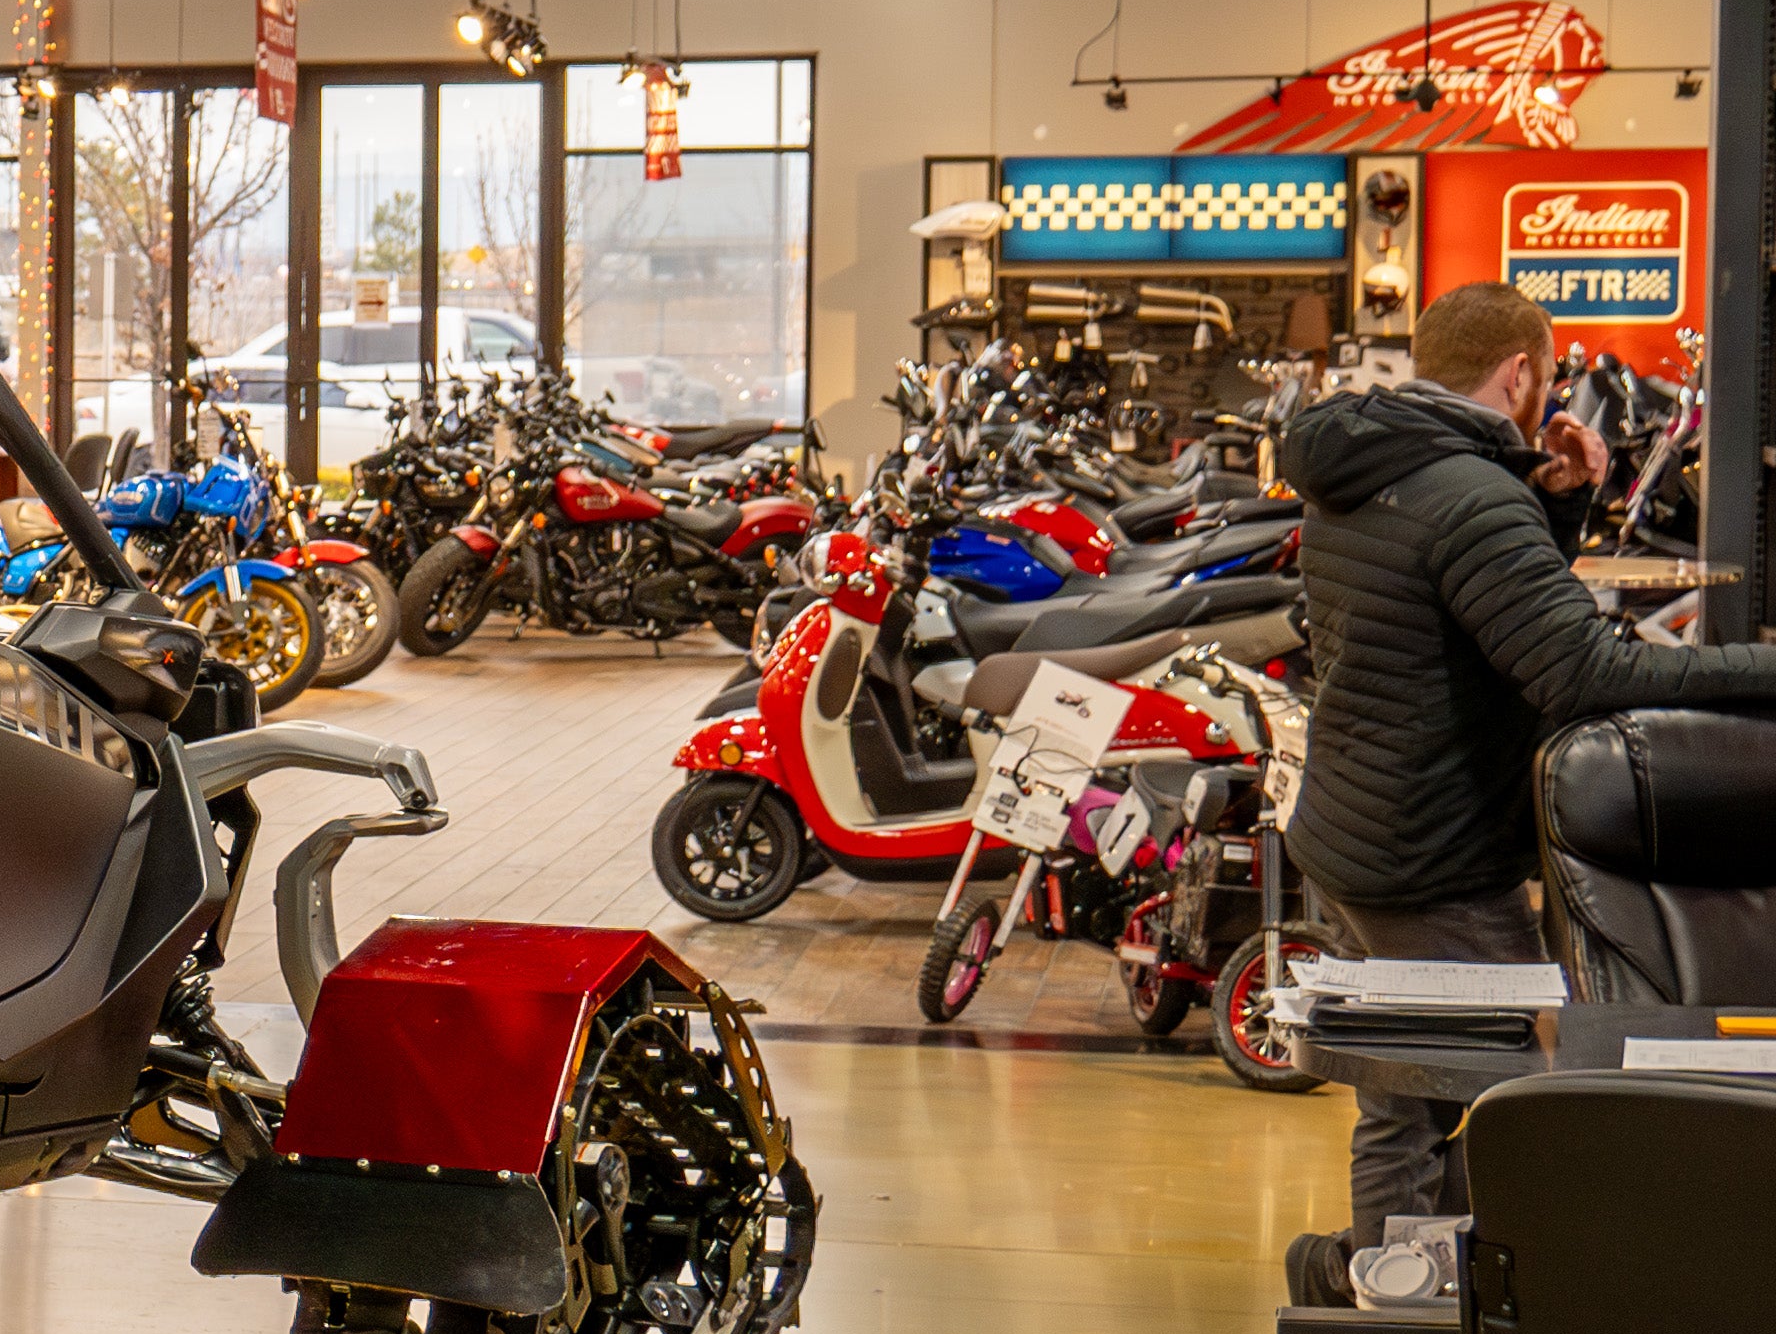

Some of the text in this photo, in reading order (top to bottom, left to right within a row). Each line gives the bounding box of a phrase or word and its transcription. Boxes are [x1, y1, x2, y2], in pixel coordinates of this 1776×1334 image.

[1519, 194, 1672, 235] Indian
[1524, 232, 1664, 247] MOTORCYCLE
[1560, 269, 1625, 302] FTR
